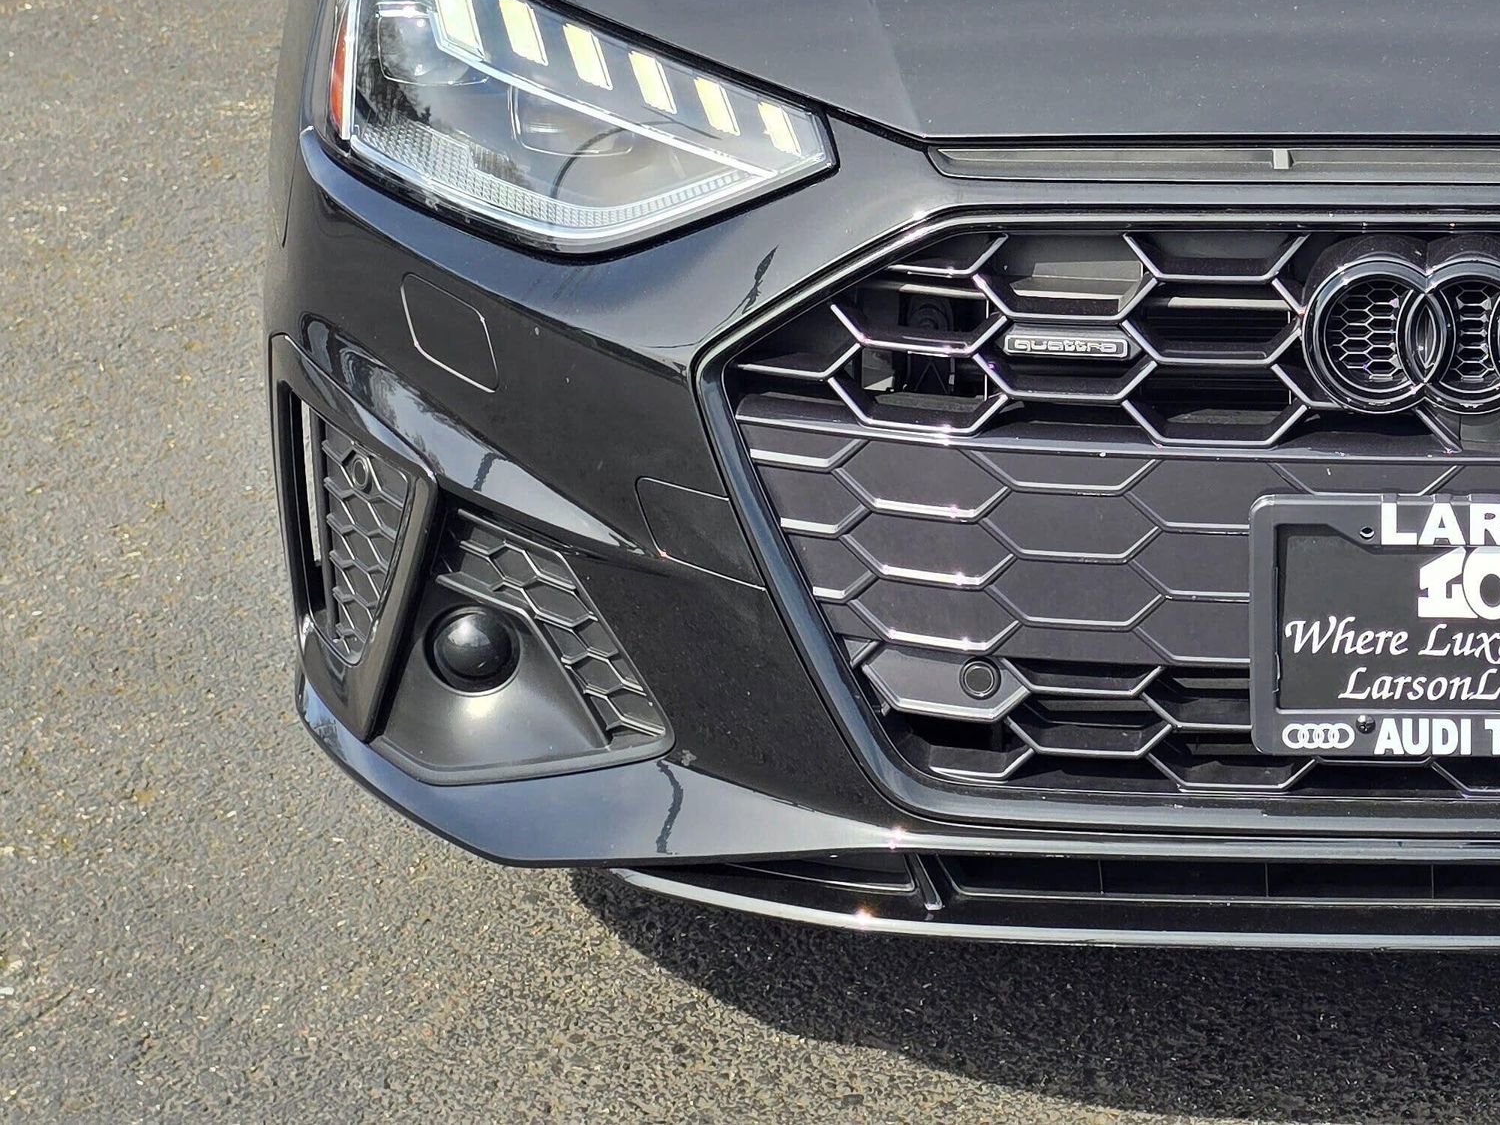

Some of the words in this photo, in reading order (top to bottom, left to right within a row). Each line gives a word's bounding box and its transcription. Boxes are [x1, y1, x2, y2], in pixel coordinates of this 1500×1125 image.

[1014, 339, 1117, 353] quattro
[1284, 616, 1408, 657] Where
[1373, 718, 1472, 757] AUDI
